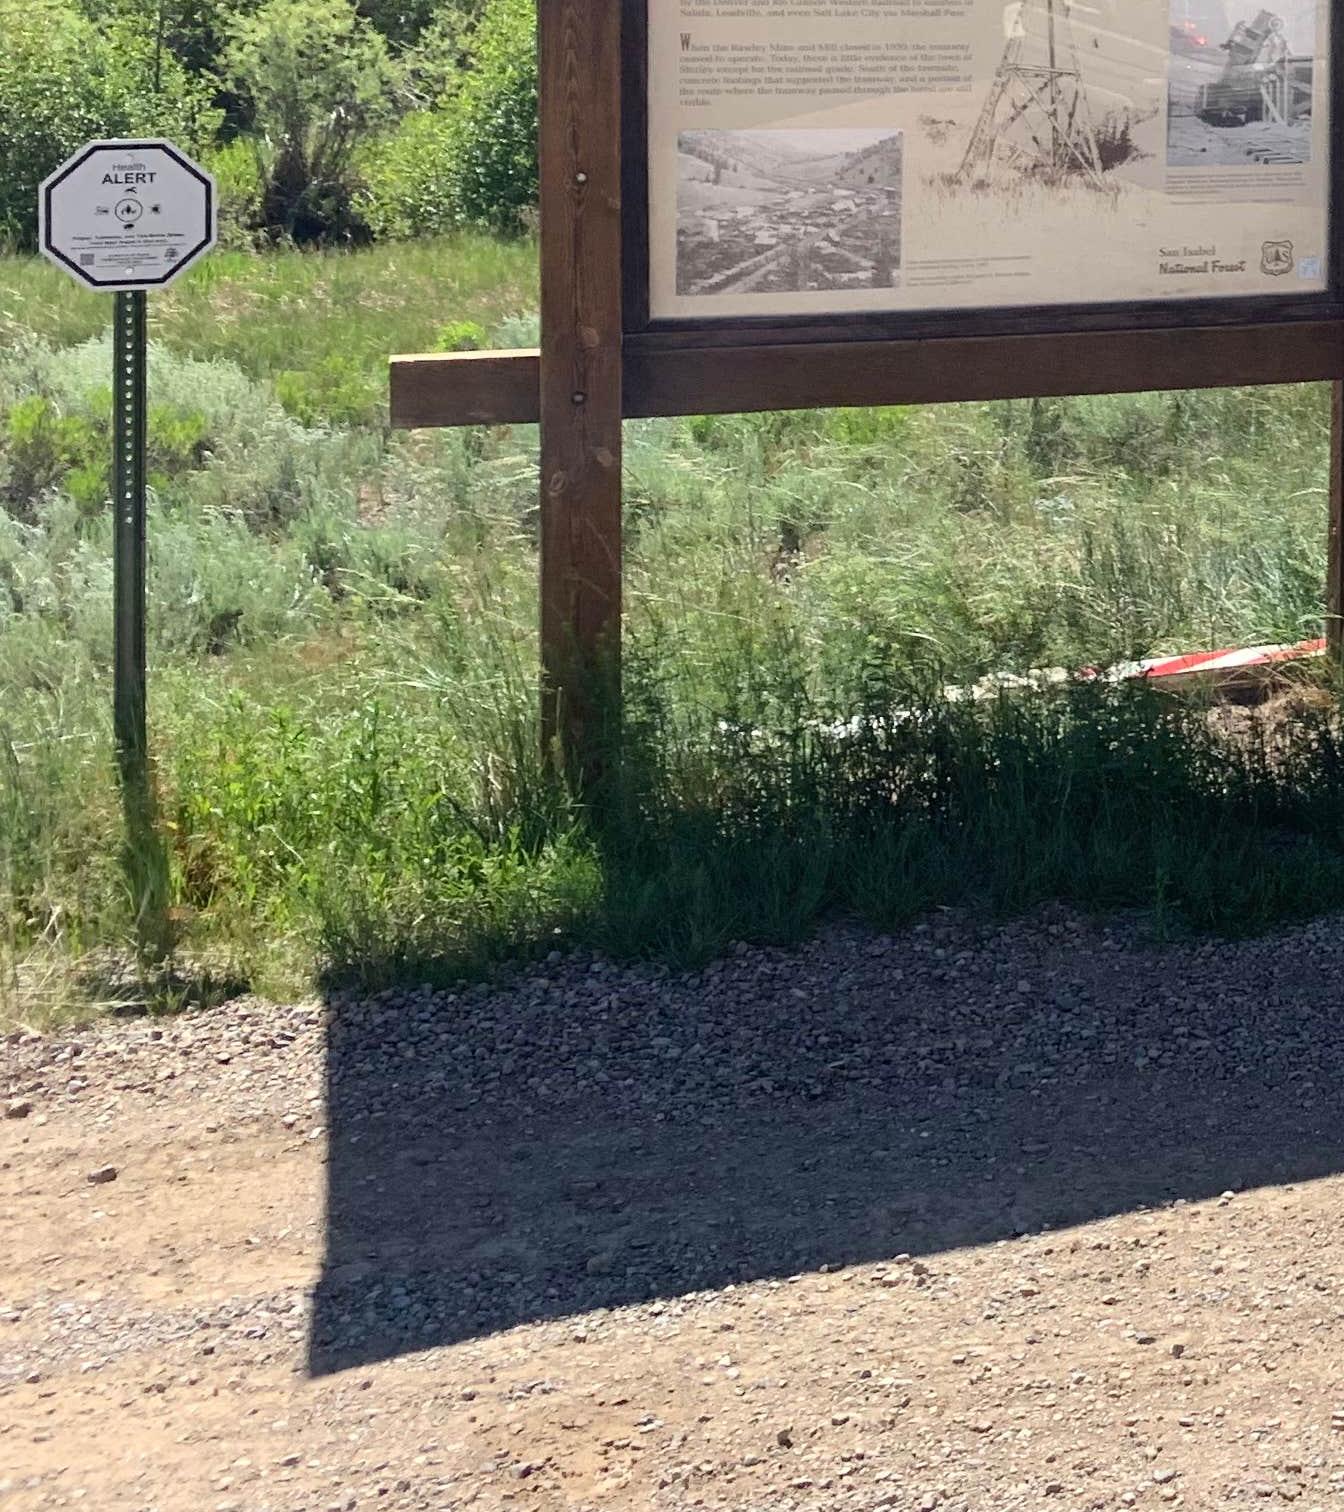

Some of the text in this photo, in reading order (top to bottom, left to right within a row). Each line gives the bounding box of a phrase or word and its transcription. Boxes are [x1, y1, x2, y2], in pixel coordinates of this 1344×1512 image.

[112, 163, 146, 172] Health
[102, 172, 157, 185] ALERT
[1159, 246, 1216, 257] San Isabel
[1159, 260, 1247, 275] National Forest
